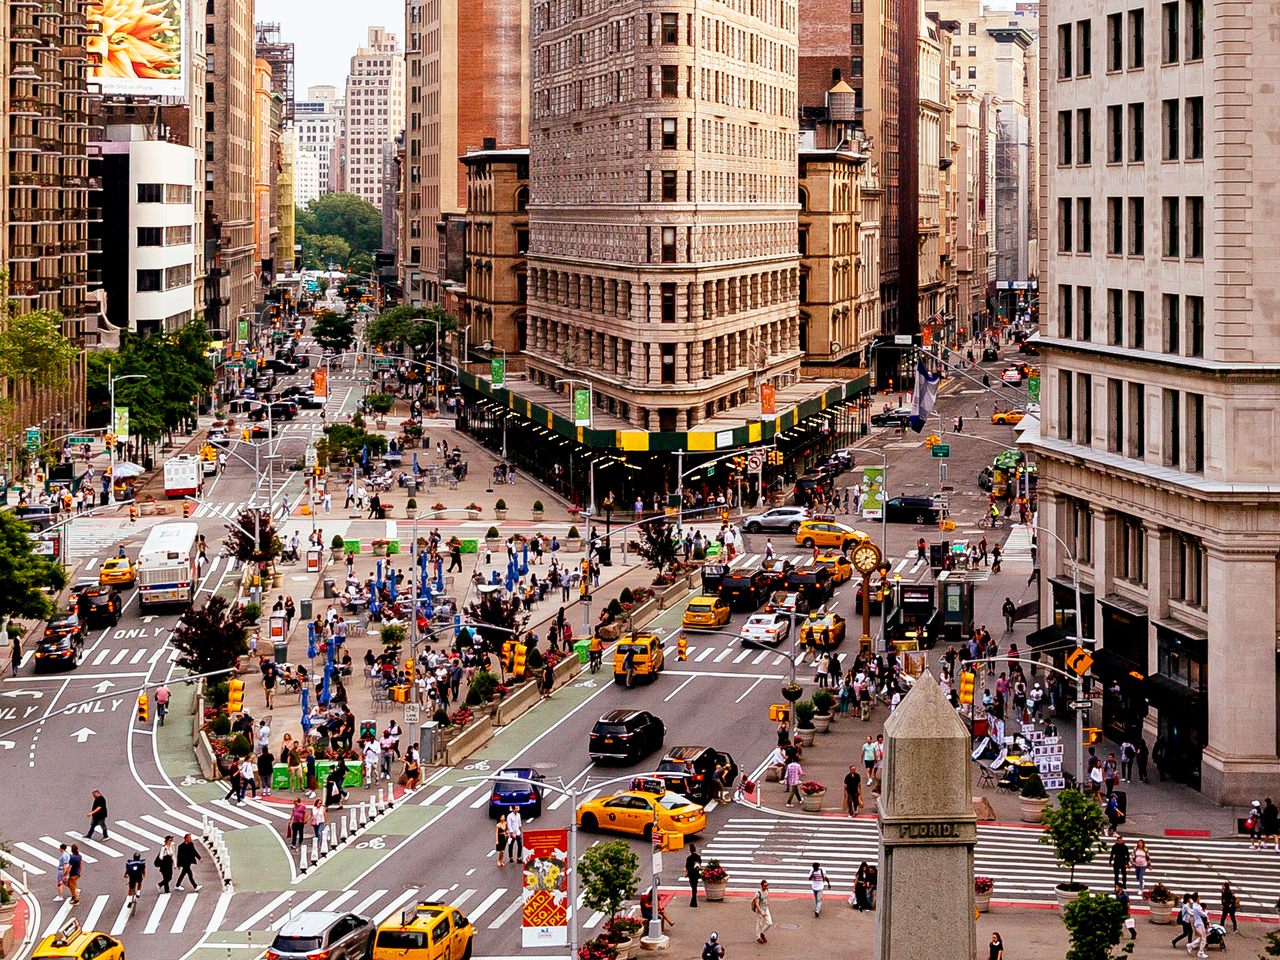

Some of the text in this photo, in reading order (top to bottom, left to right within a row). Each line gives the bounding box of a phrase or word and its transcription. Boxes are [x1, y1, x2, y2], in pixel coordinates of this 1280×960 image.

[113, 626, 165, 639] ONLY
[63, 699, 124, 715] ONLY
[900, 824, 960, 838] FLORIDA
[524, 894, 549, 916] MAD.
[533, 910, 551, 925] SQ.
[549, 912, 566, 926] PK.
